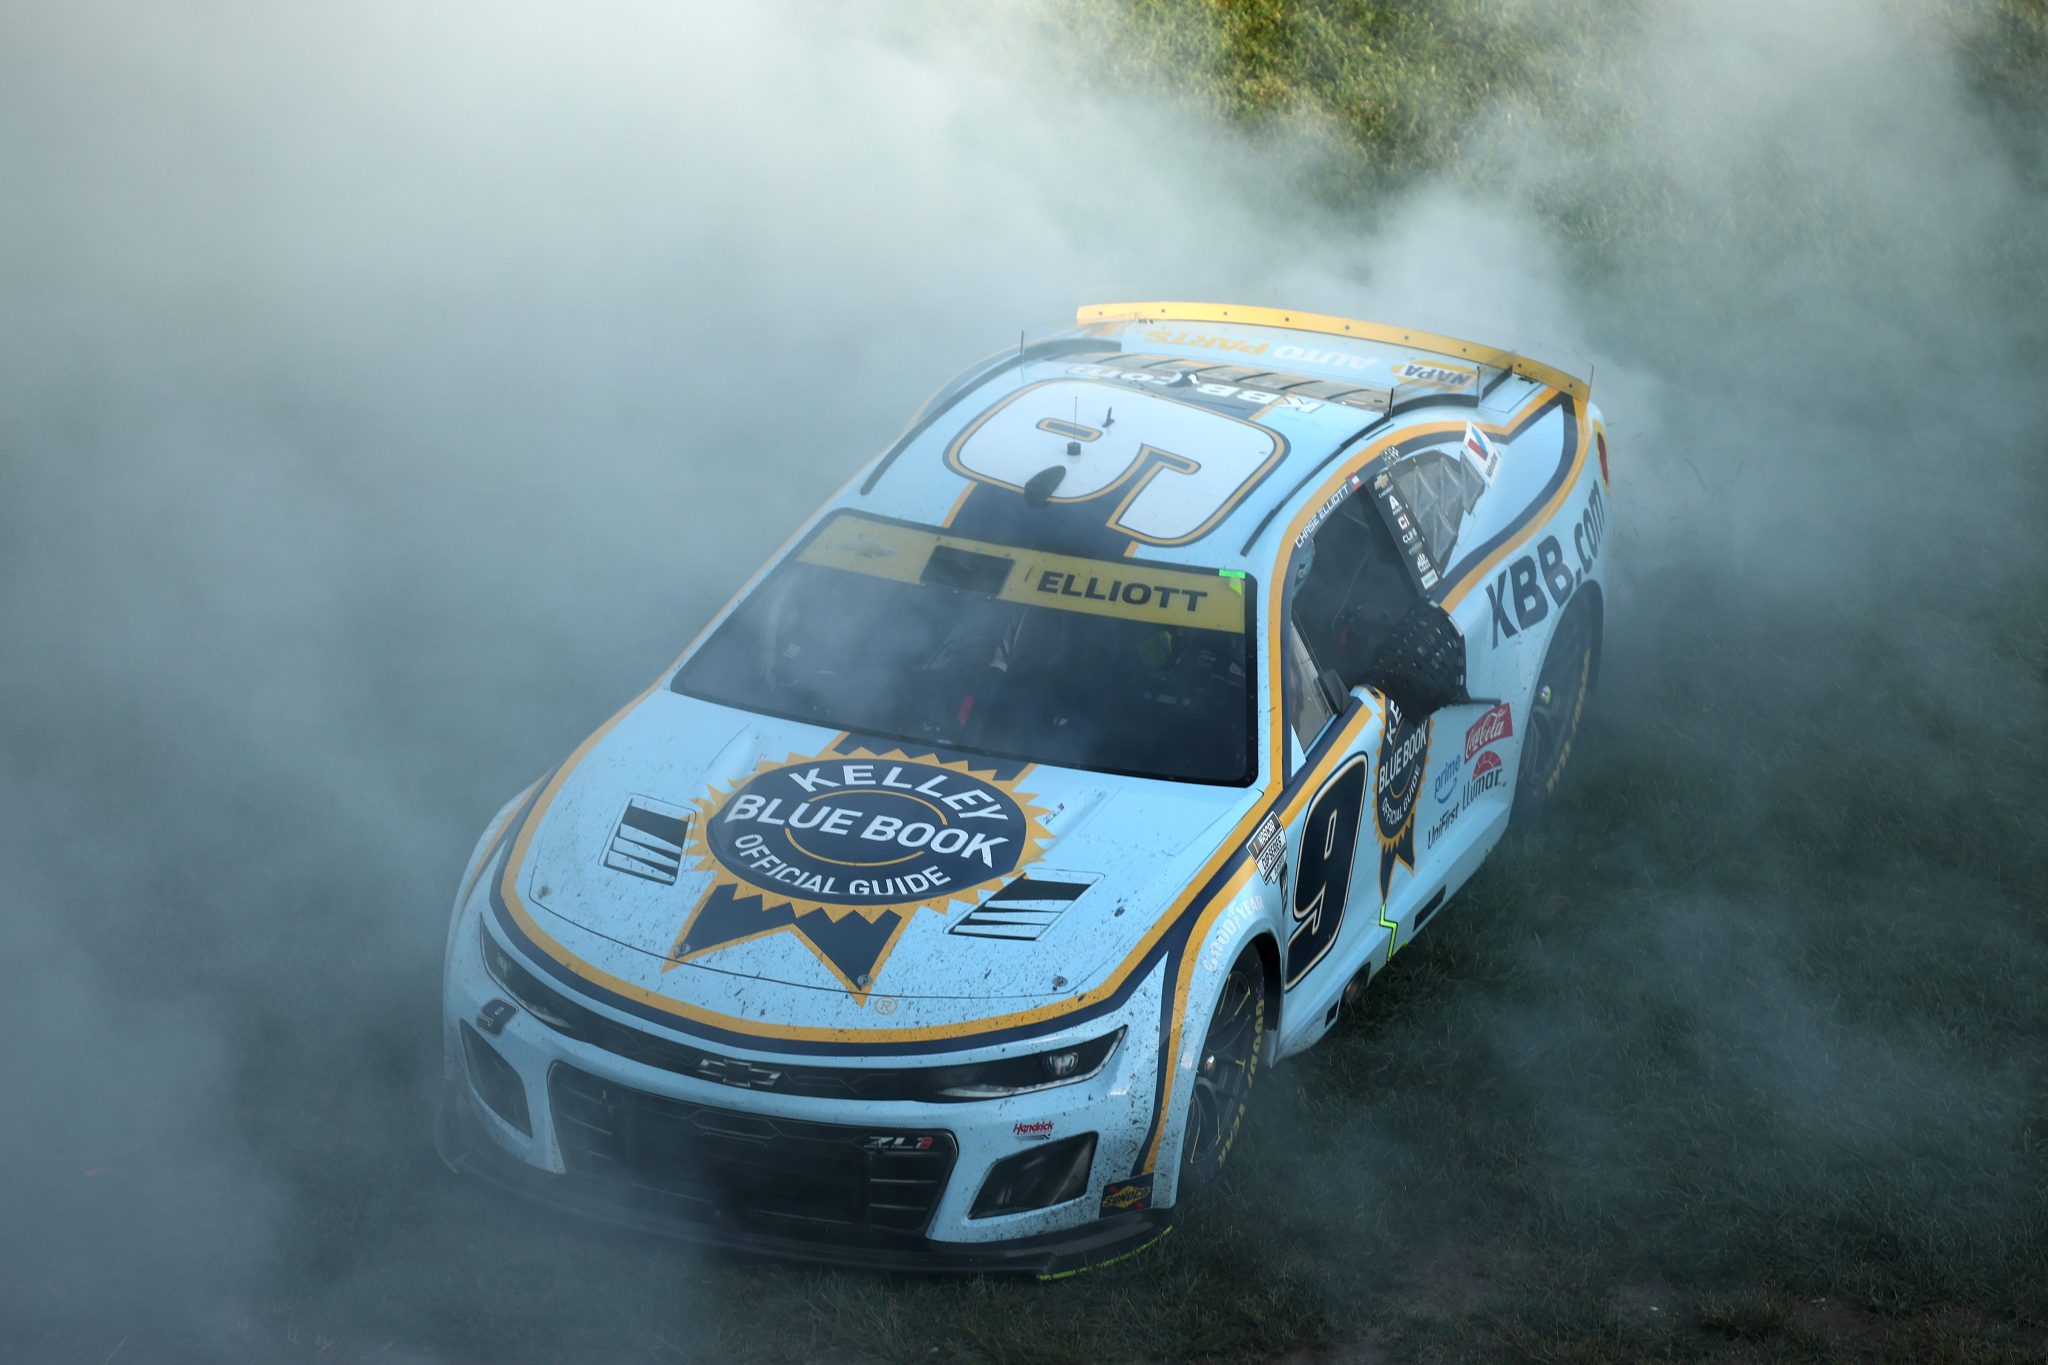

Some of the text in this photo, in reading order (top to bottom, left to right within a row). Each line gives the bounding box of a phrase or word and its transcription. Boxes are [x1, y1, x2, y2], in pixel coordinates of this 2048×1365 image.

[1143, 328, 1474, 386] NAPA AUTO PARTS
[1066, 364, 1325, 414] KBBcom
[1295, 484, 1349, 548] CHASE ELLIOTT
[1036, 570, 1208, 612] ELLIOTT
[1485, 479, 1605, 650] KBB.com
[1378, 746, 1403, 794] BLUE
[1402, 719, 1428, 768] BOOK
[1434, 754, 1461, 799] prime
[788, 764, 1011, 821] KELLEY
[1403, 763, 1421, 811] GUIDE
[724, 794, 1010, 869] BLUE BOOK
[1427, 802, 1460, 850] UniFirst
[734, 833, 953, 897] OFFICIAL GUIDE
[1285, 750, 1369, 994] 9
[1013, 1120, 1054, 1136] Hendrick
